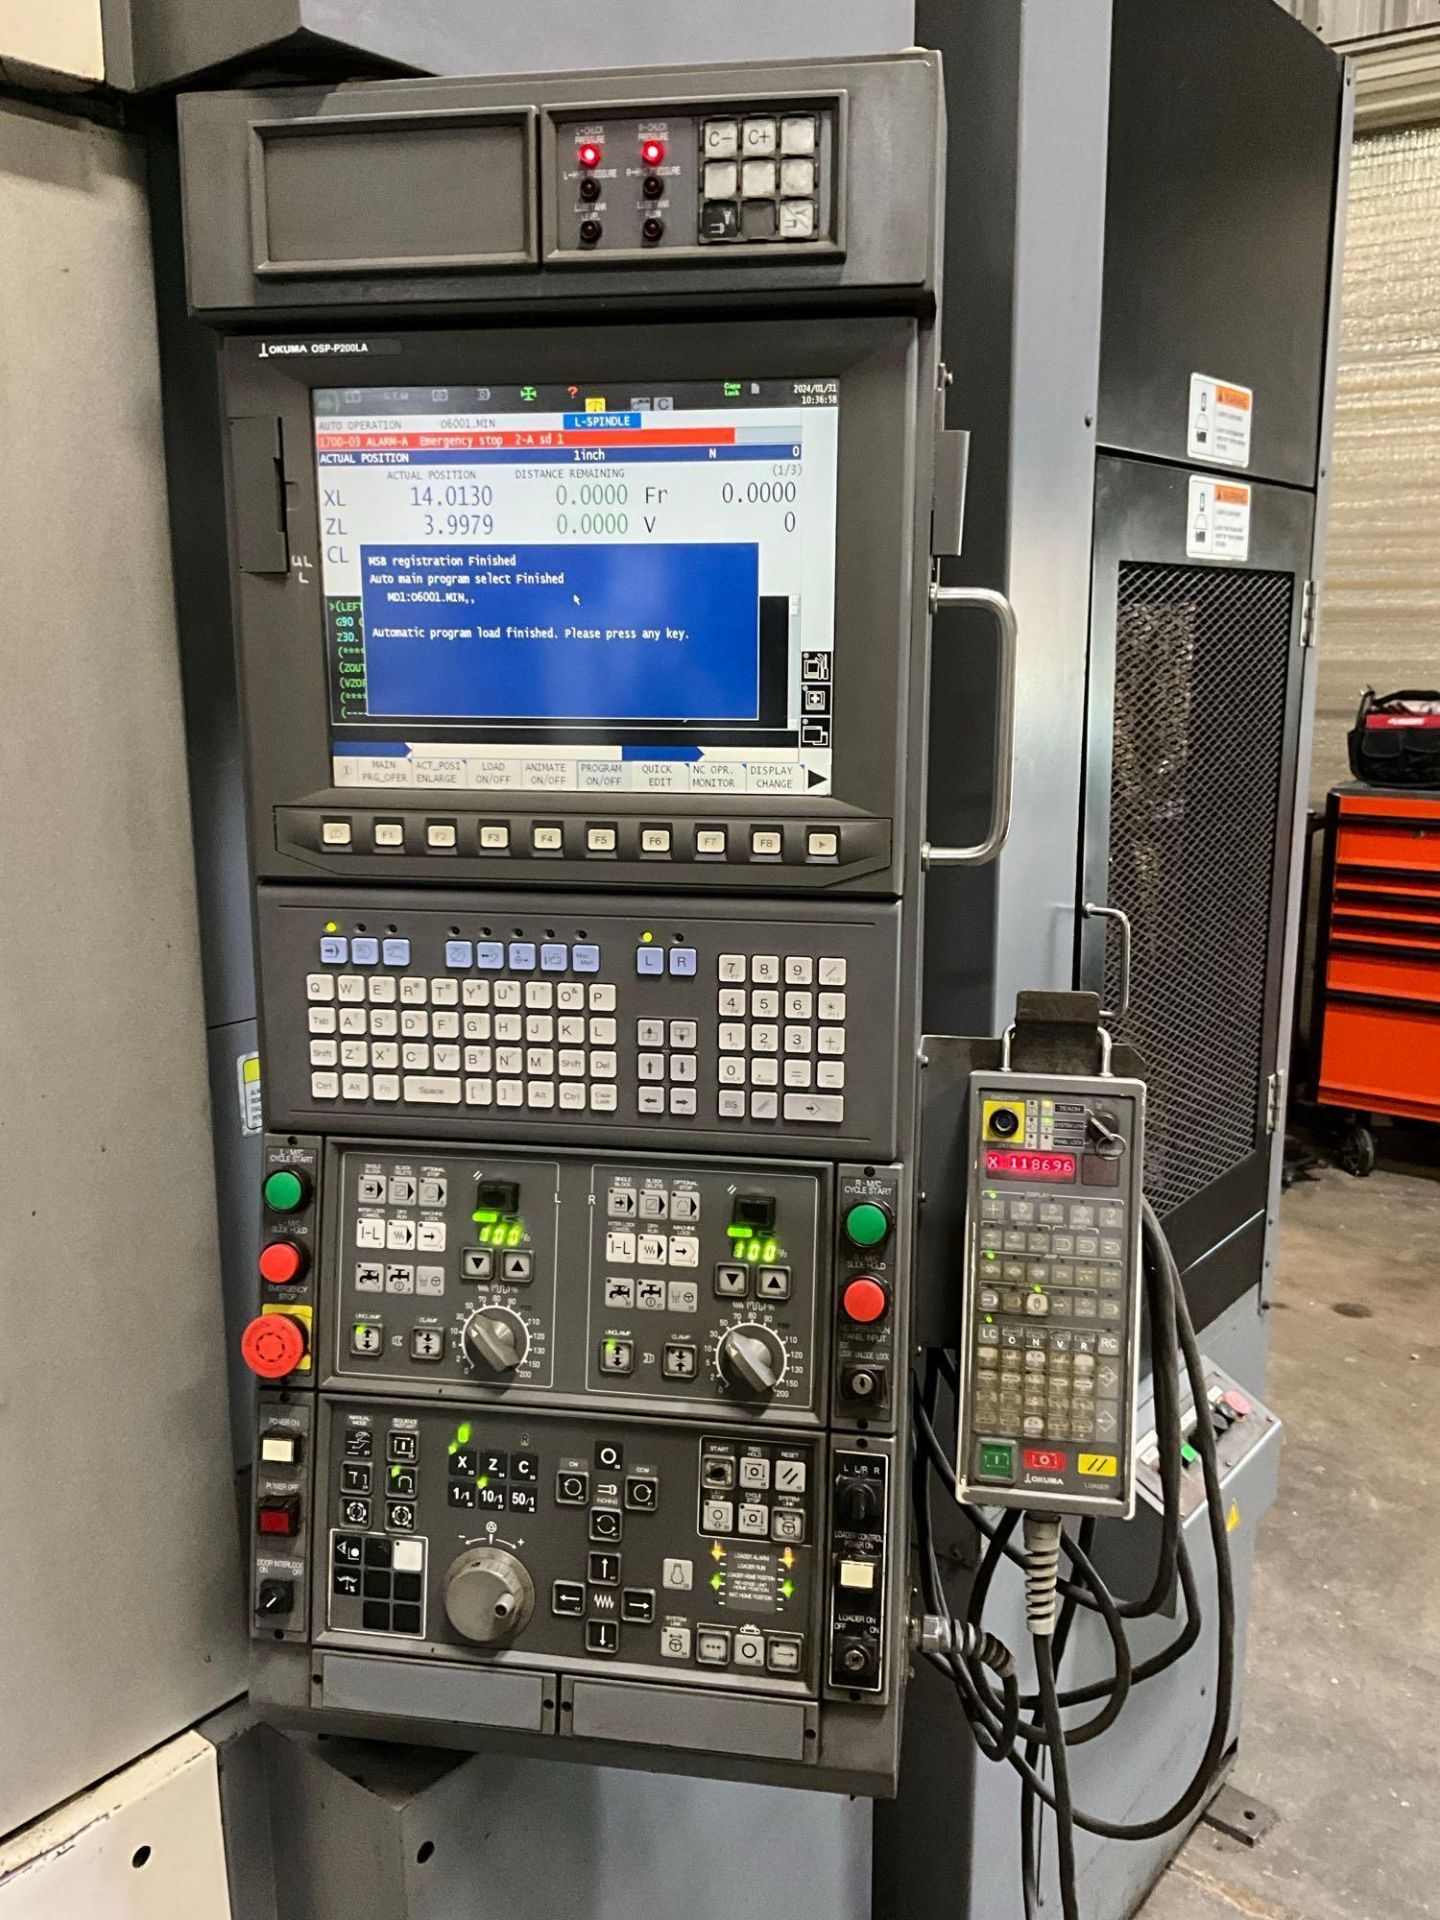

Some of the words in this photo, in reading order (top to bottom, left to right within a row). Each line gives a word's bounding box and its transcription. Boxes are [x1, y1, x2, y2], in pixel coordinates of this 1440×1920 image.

[748, 130, 769, 145] C+
[269, 344, 307, 354] OKUMA
[311, 343, 368, 353] OSP-P200LA
[319, 421, 342, 430] AUTO
[347, 421, 402, 430] OPERATION
[574, 416, 630, 427] L-SPINDLE
[319, 436, 361, 447] 1700-03
[367, 436, 409, 447] ALARM-A
[420, 435, 473, 448] Emergency
[479, 435, 503, 447] stop
[515, 434, 534, 445] 2-A
[540, 433, 552, 444] sd
[557, 434, 564, 444] 1
[709, 448, 716, 458] N
[320, 454, 356, 464] ACTUAL
[361, 453, 409, 463] POSITION
[387, 471, 423, 480] ACTUAL
[428, 470, 476, 480] POSITION
[515, 469, 563, 478] DISTANCE
[570, 468, 625, 478] REMAINING
[773, 464, 802, 477] (1/3)
[411, 485, 493, 506] 14.0130
[556, 484, 628, 506] 0.0000
[645, 487, 667, 504] Fr
[722, 481, 796, 503] 0.0000
[324, 490, 346, 506] XL
[326, 518, 348, 535] ZL
[425, 514, 493, 535] 3.9979
[557, 513, 628, 534] 0.0000
[644, 516, 656, 533] V
[784, 511, 796, 532] 0
[327, 546, 348, 563] CL
[392, 555, 463, 568] registration
[469, 556, 516, 566] Finished
[370, 575, 394, 584] Auto
[398, 573, 422, 584] main
[428, 575, 470, 587] program
[475, 574, 511, 584] select
[516, 573, 564, 584] Finished
[372, 628, 425, 638] Automatic
[430, 629, 472, 640] program
[477, 627, 500, 638] load
[507, 628, 558, 638] finished.
[565, 628, 600, 639] Please
[606, 629, 636, 641] press
[642, 629, 660, 640] any
[666, 628, 689, 641] key.
[416, 761, 460, 770] ACT_POSI
[481, 762, 505, 771] LOAD
[526, 763, 567, 772] ANIMATE
[581, 764, 622, 773] PROGRAM
[642, 765, 672, 774] QUICK
[693, 765, 705, 774] NC
[710, 766, 734, 775] OPR.
[750, 766, 792, 775] DISPLAY
[362, 774, 407, 783] PRG_OPER
[417, 774, 456, 783] ENLARGE
[476, 774, 511, 785] ON/OFF
[530, 775, 567, 785] ON/OFF
[587, 776, 622, 786] ON/OFF
[648, 778, 672, 787] EDIT
[693, 778, 735, 788] MONITOR
[756, 779, 792, 789] CHANGE
[382, 831, 393, 839] F1
[435, 832, 447, 841] F2
[488, 833, 500, 842] F3
[541, 834, 553, 843] F4
[595, 836, 607, 845] F5
[649, 837, 661, 846] F6
[704, 837, 716, 846] F7
[760, 839, 772, 847] F8
[646, 957, 652, 966] L
[677, 957, 686, 967] R
[726, 963, 735, 973] 7
[760, 964, 769, 974] 8
[793, 965, 802, 976] 9
[373, 985, 381, 995] E
[404, 986, 413, 996] R
[467, 988, 476, 997] Y
[498, 989, 507, 999] U
[594, 993, 602, 1003] P
[727, 998, 735, 1008] 4
[760, 999, 768, 1009] 5
[793, 1000, 802, 1010] 6
[344, 1017, 352, 1026] A
[375, 1018, 383, 1028] S
[406, 1019, 414, 1028] D
[468, 1021, 477, 1031] G
[499, 1023, 508, 1033] H
[562, 1025, 571, 1035] K
[595, 1026, 602, 1036] L
[760, 1033, 768, 1043] 2
[793, 1034, 801, 1045] 3
[345, 1050, 354, 1059] Z
[376, 1051, 384, 1060] X
[469, 1054, 477, 1064] B
[500, 1056, 509, 1066] N
[531, 1057, 541, 1067] M
[561, 1060, 581, 1068] Shift
[419, 1086, 444, 1095] Space
[1011, 1158, 1072, 1171] 118696
[845, 1186, 867, 1194] CYCLE
[869, 1187, 892, 1195] START
[555, 1193, 561, 1203] L
[588, 1195, 596, 1205] R
[982, 1329, 997, 1338] LC
[1101, 1338, 1117, 1348] RC
[458, 1456, 467, 1468] X
[489, 1458, 498, 1471] Z
[518, 1461, 528, 1473] C
[855, 1465, 867, 1473] L/R
[1031, 1477, 1064, 1485] OKUMA
[453, 1487, 470, 1500] 1/1
[481, 1490, 503, 1503] 10/1
[512, 1492, 534, 1506] 50/1
[257, 1559, 272, 1567] DOOR
[839, 1613, 864, 1624] LOADER
[870, 1625, 879, 1633] ON
